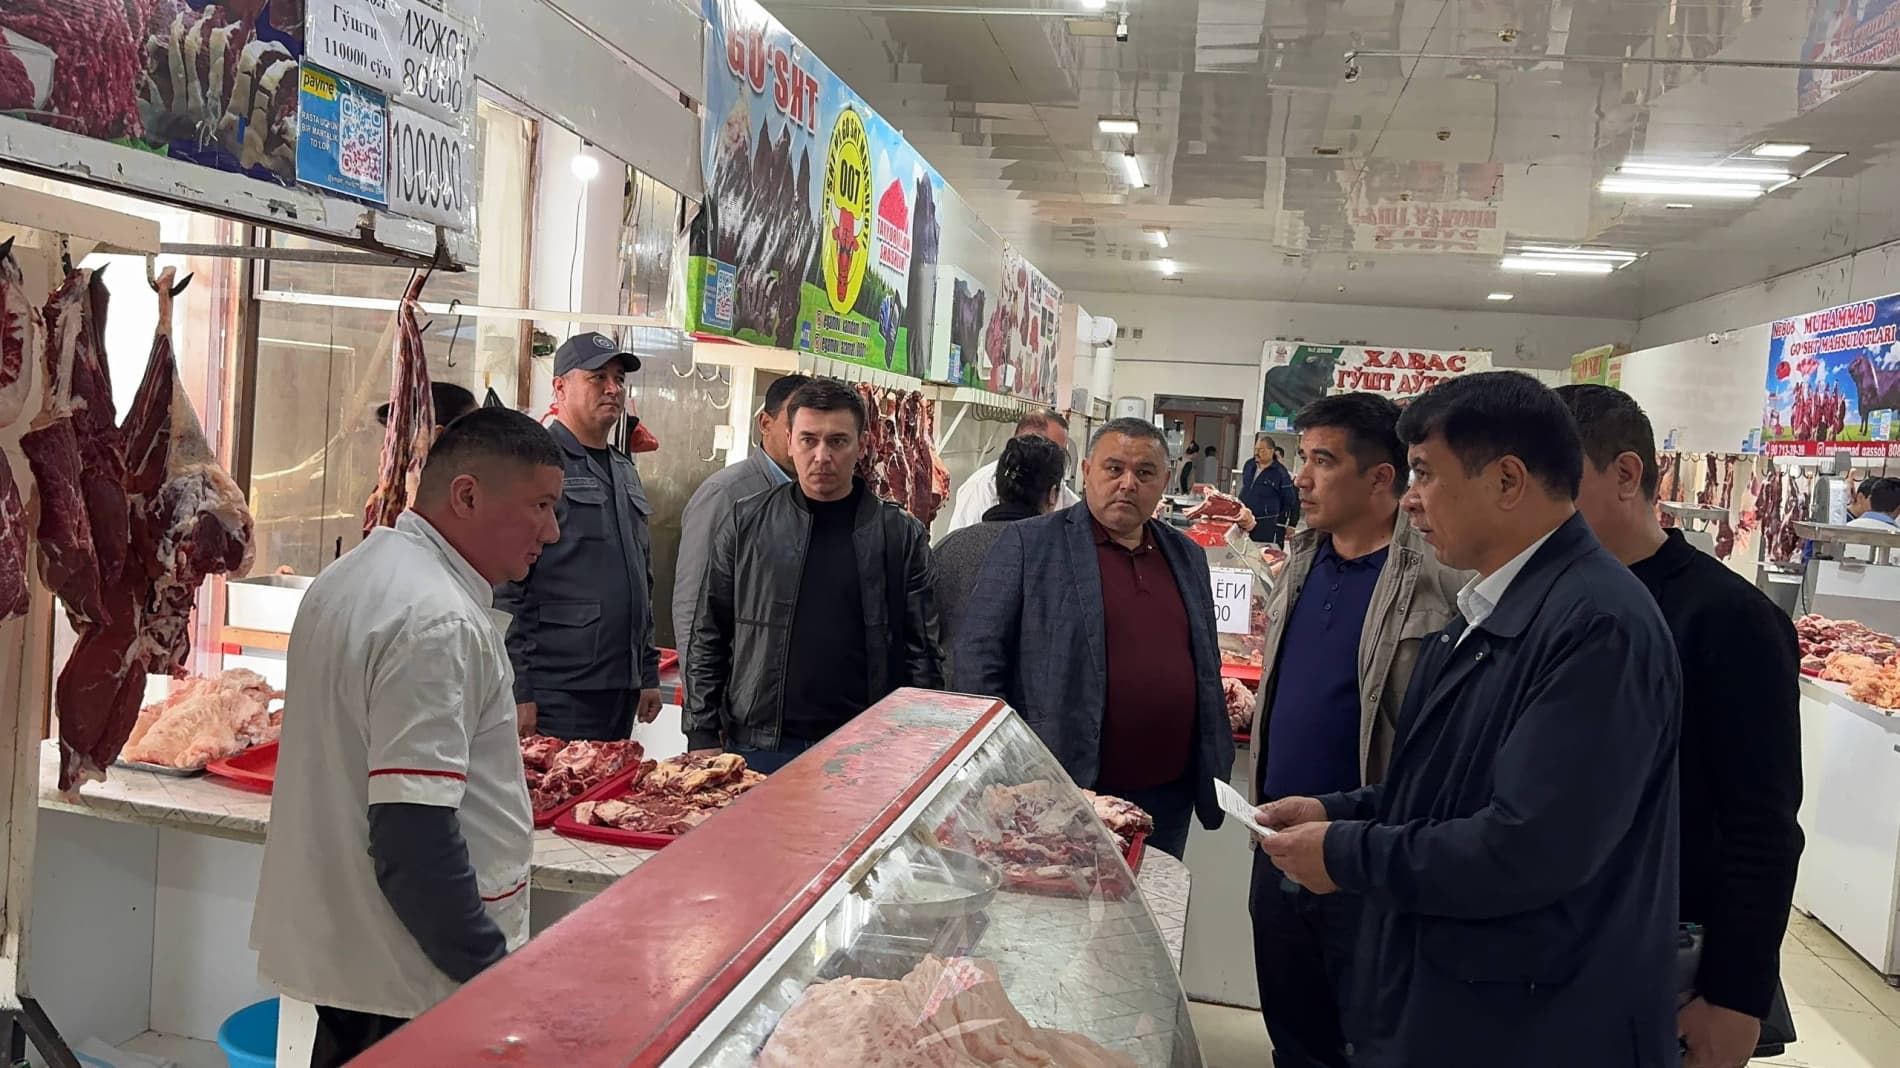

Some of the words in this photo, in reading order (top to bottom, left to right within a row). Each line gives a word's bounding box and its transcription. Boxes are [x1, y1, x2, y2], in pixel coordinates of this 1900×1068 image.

[333, 4, 378, 41] Гўшти
[323, 37, 367, 69] 110000
[370, 58, 392, 79] сўм
[303, 73, 335, 95] payme
[404, 58, 462, 113] 80000
[301, 111, 319, 125] RASTA
[301, 122, 312, 134] BIR
[393, 120, 463, 211] 100000
[840, 158, 861, 205] 007
[1803, 303, 1876, 334] MUHAMMAD
[1791, 340, 1820, 356] GO'SHT
[1820, 325, 1896, 351] MAHSULOTLARI
[1364, 350, 1467, 372] ХАВАС
[1337, 366, 1395, 392] ГЎШТ
[1215, 578, 1247, 600] ЁГИ
